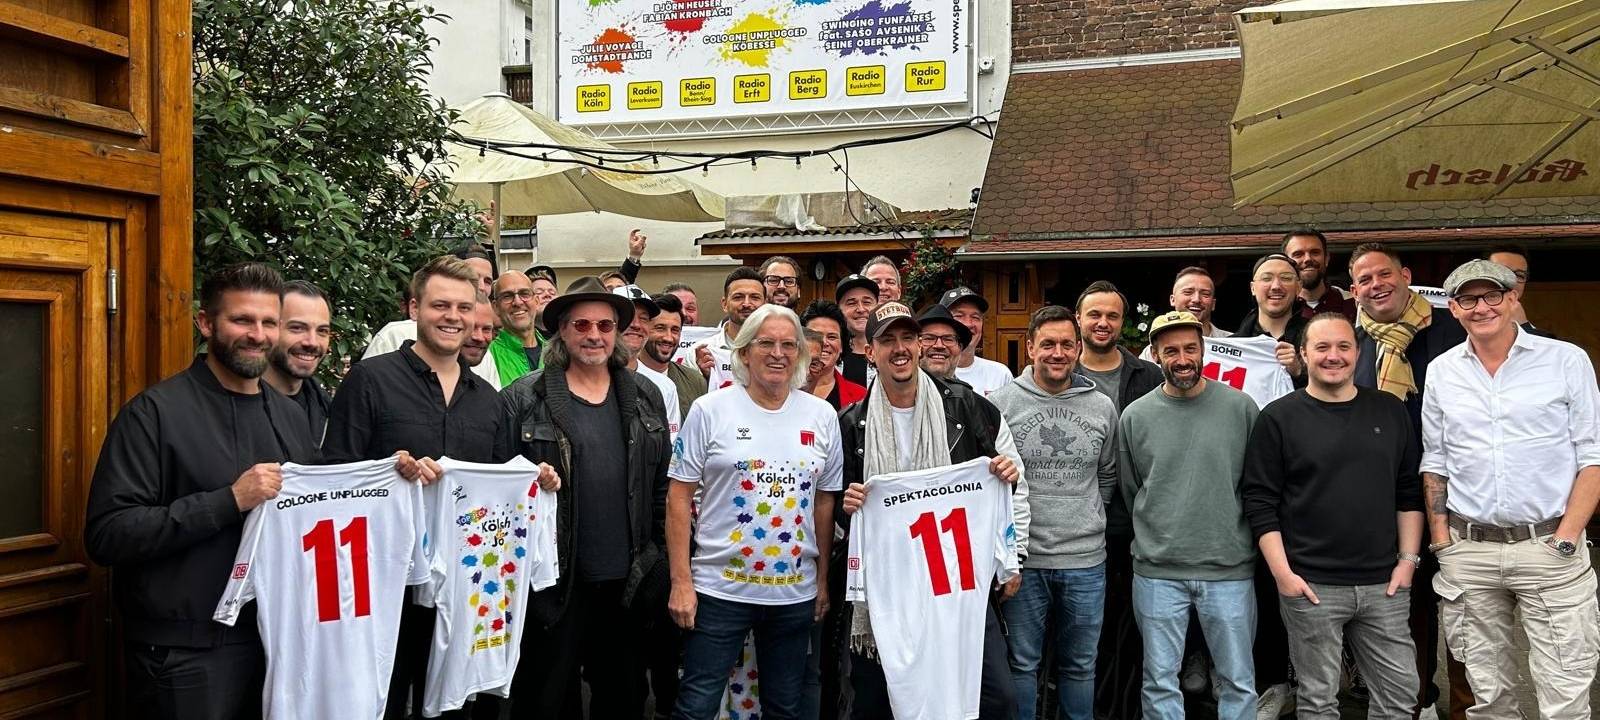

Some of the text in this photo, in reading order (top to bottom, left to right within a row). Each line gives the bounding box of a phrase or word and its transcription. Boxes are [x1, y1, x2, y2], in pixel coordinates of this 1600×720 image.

[653, 0, 721, 12] BJÖRN HEUSER
[643, 7, 732, 23] FABIAN KRONBACH
[822, 13, 932, 30] SWINGING FUNFARES
[703, 27, 807, 44] COLOGNE UNPLUGGED
[819, 23, 935, 41] feat. SAŠO AVSENIK &
[825, 33, 928, 50] SEINE OBERKRAINER
[581, 41, 643, 54] JULIE VOYAGE
[572, 50, 652, 64] DOMSTADTBANDE
[852, 71, 880, 81] Radio
[911, 67, 940, 76] Radio
[739, 79, 765, 88] Radio
[794, 75, 821, 84] Radio
[917, 77, 934, 86] Rur
[632, 86, 657, 95] Radio
[685, 81, 711, 90] Radio
[797, 85, 819, 95] Berg
[582, 89, 606, 98] Radio
[744, 88, 760, 98] Erft
[584, 98, 603, 107] Köln
[1211, 345, 1243, 358] BOHEI
[1046, 407, 1095, 437] VINTAGE
[756, 473, 795, 484] Kölsch
[1030, 472, 1058, 480] TRADE
[767, 488, 785, 498] Jot
[884, 482, 983, 507] SPEKTACOLONIA
[277, 488, 389, 510] COLOGNE UNPLUGGED
[909, 507, 976, 597] 11
[302, 516, 371, 623] 11
